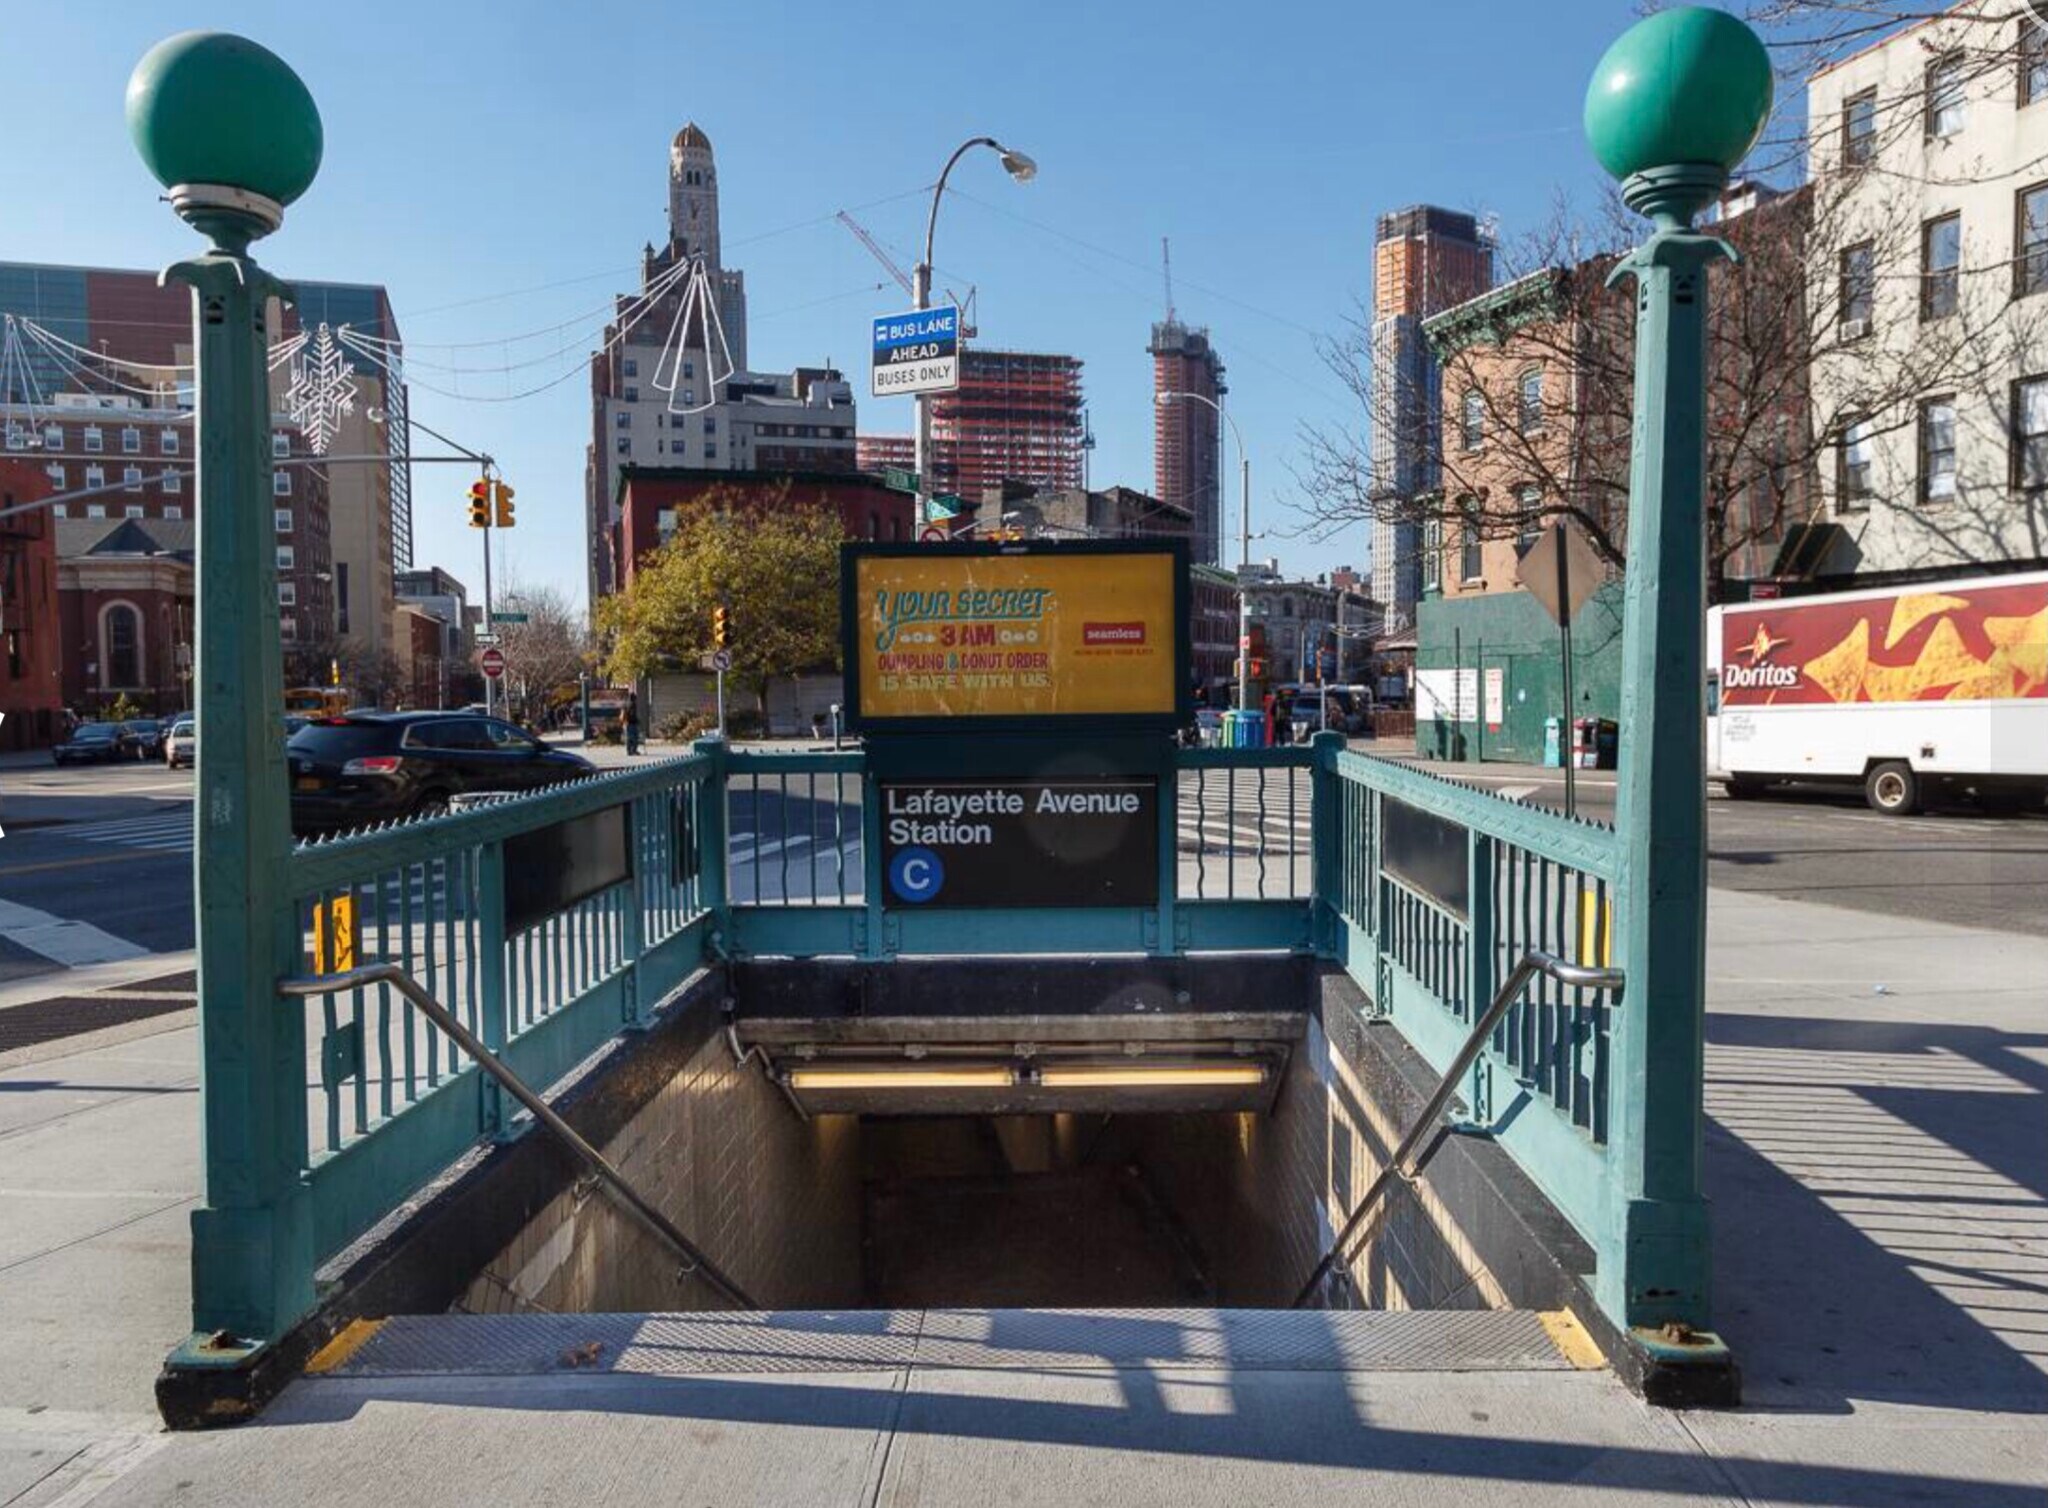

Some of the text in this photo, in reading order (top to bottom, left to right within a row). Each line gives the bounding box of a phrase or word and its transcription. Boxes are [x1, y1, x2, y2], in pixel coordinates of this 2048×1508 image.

[890, 316, 954, 339] BUS LANE
[890, 343, 939, 362] AHEAD
[877, 365, 951, 386] BUSES ONLY
[940, 624, 996, 647] 3 AM
[1086, 627, 1142, 639] seamless
[878, 652, 944, 671] DUMPLING
[961, 652, 1003, 670] DONUT
[1007, 652, 1048, 670] ORDER
[879, 674, 899, 691] IS
[905, 673, 958, 690] SAFE
[963, 672, 1014, 688] WITH
[1725, 661, 1798, 688] Doritos
[888, 788, 1140, 819] Lafayette Avenue
[889, 819, 992, 845] Station
[903, 859, 930, 890] C
